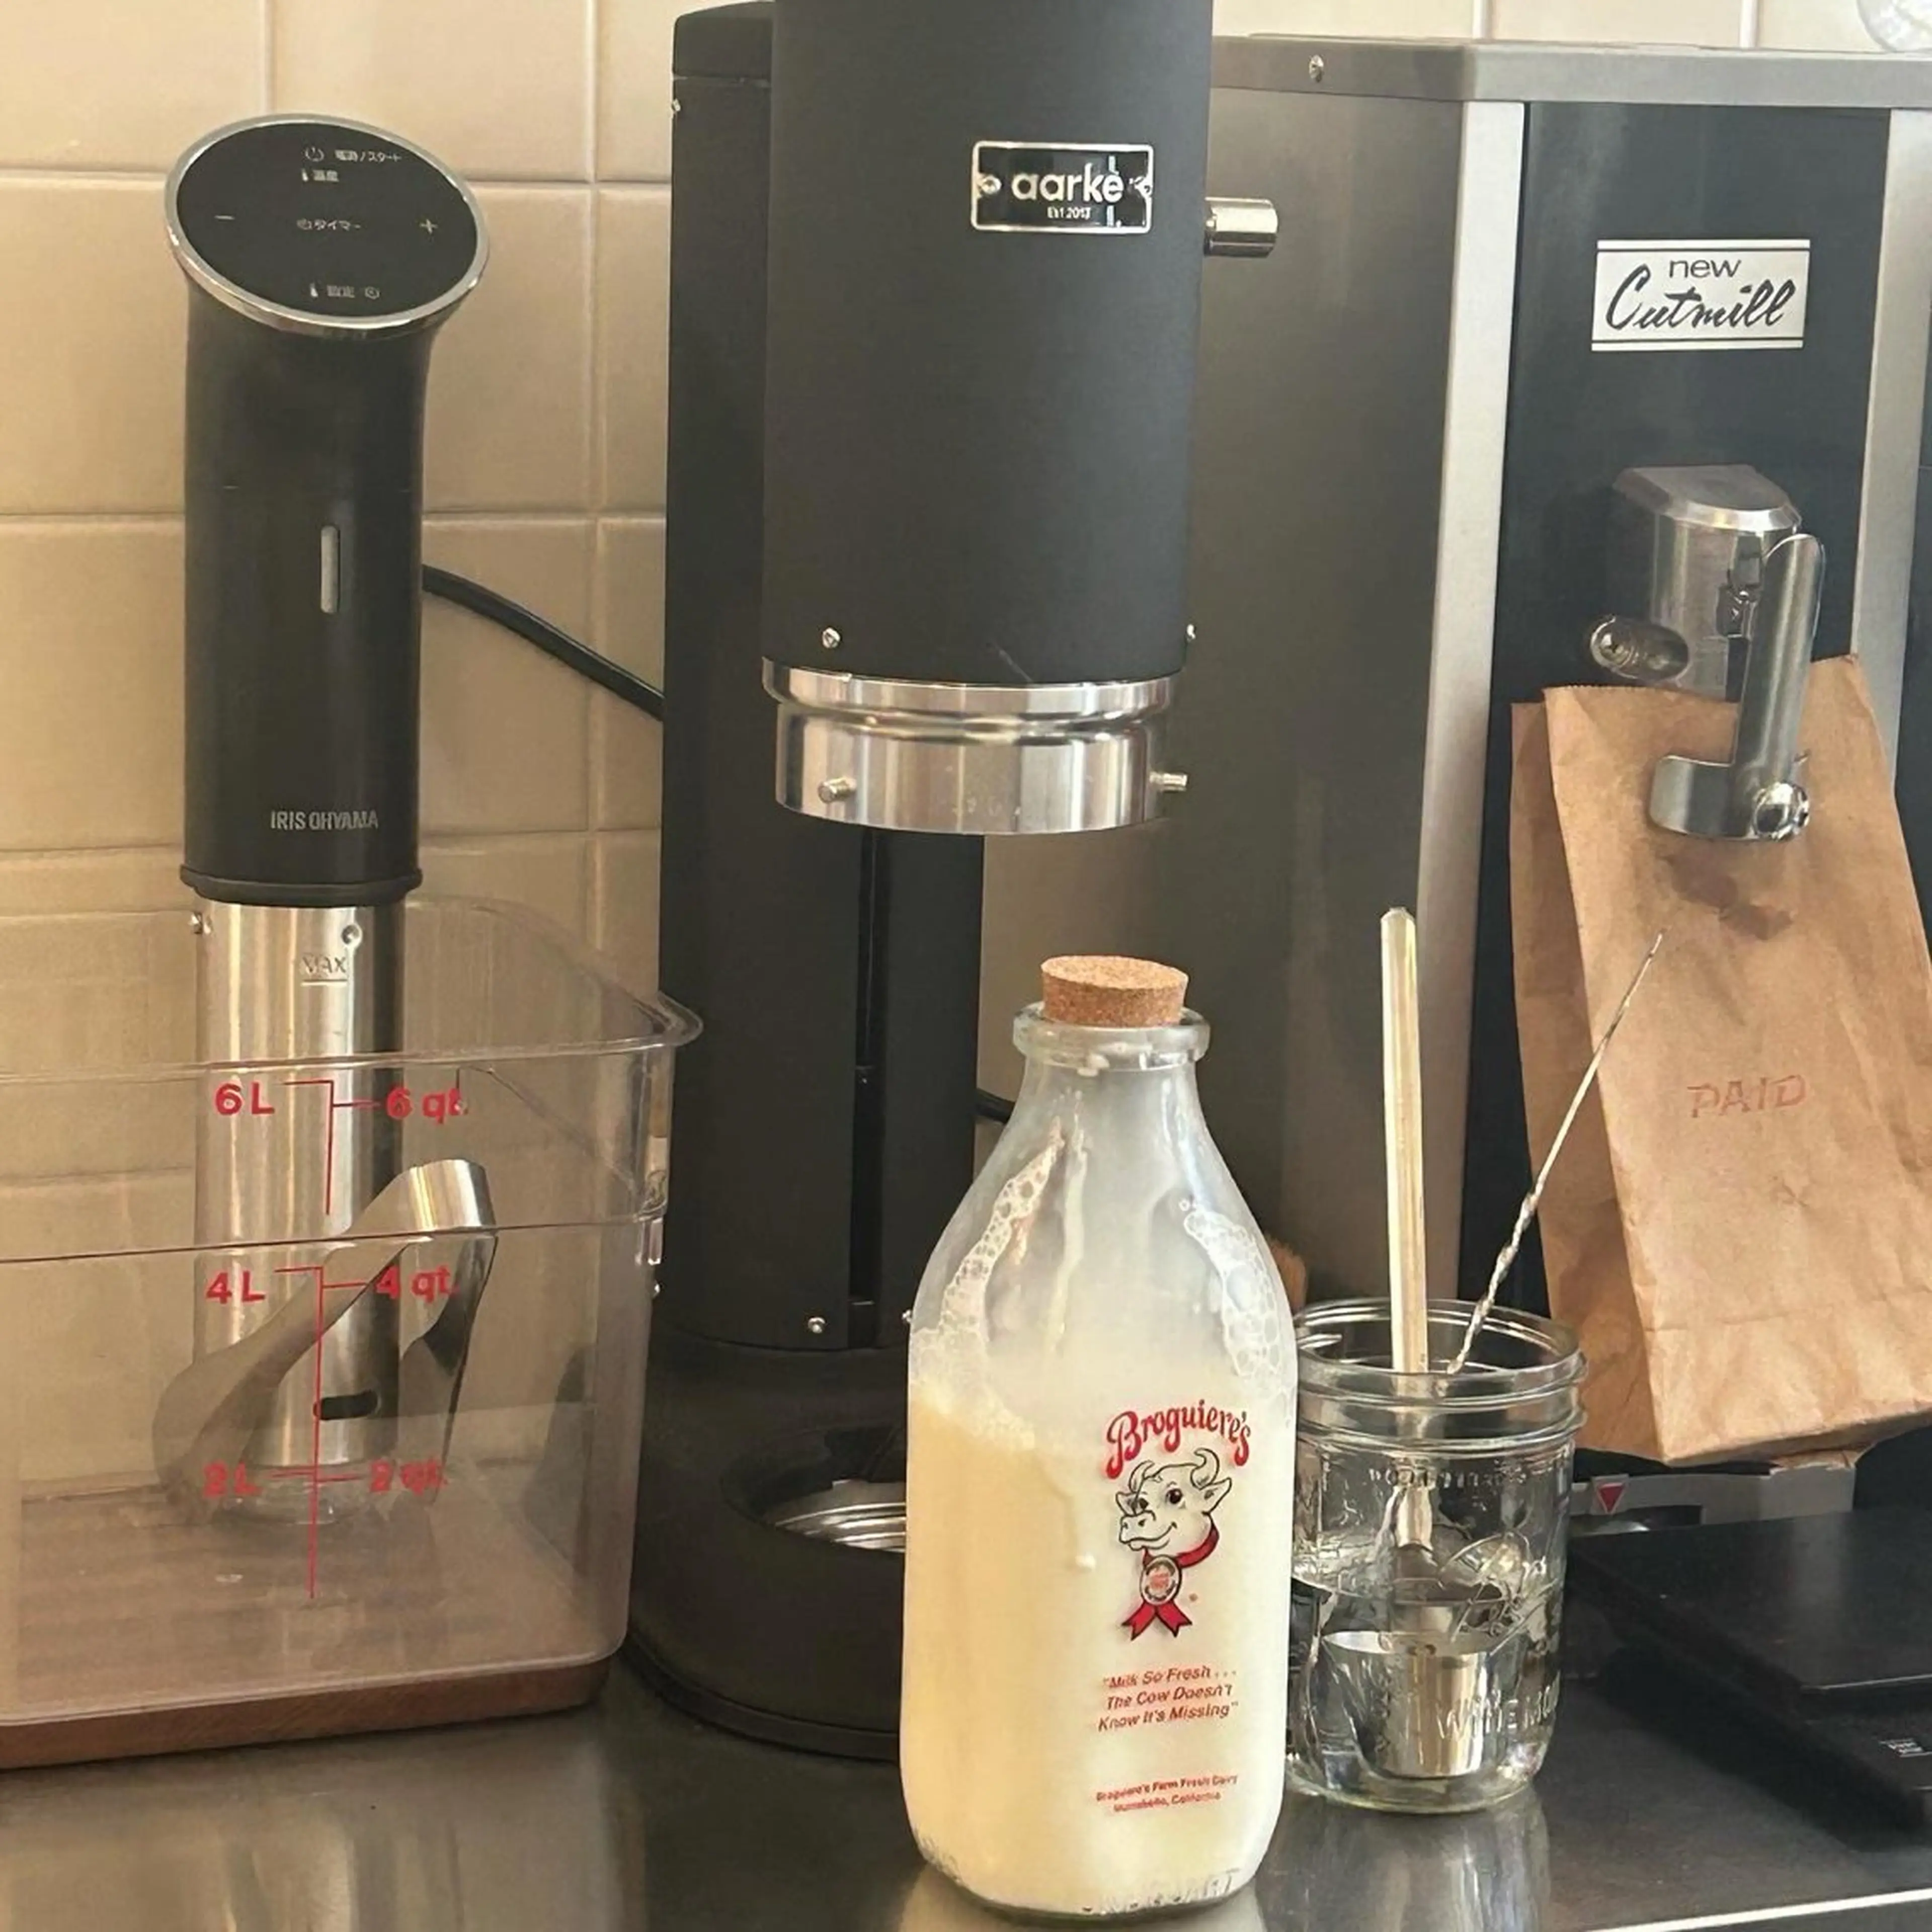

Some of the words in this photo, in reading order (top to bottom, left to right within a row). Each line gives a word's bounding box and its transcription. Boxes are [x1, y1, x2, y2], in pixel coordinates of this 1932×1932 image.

[1011, 162, 1124, 203] aarke
[1669, 259, 1742, 278] new
[1605, 263, 1796, 330] Cutmill
[271, 810, 306, 831] IRIS
[1686, 1074, 1806, 1118] PAID
[1106, 1399, 1251, 1479] Broguiere's
[1142, 1670, 1163, 1685] So
[1136, 1689, 1171, 1706] Cow
[1098, 1715, 1141, 1732] Know
